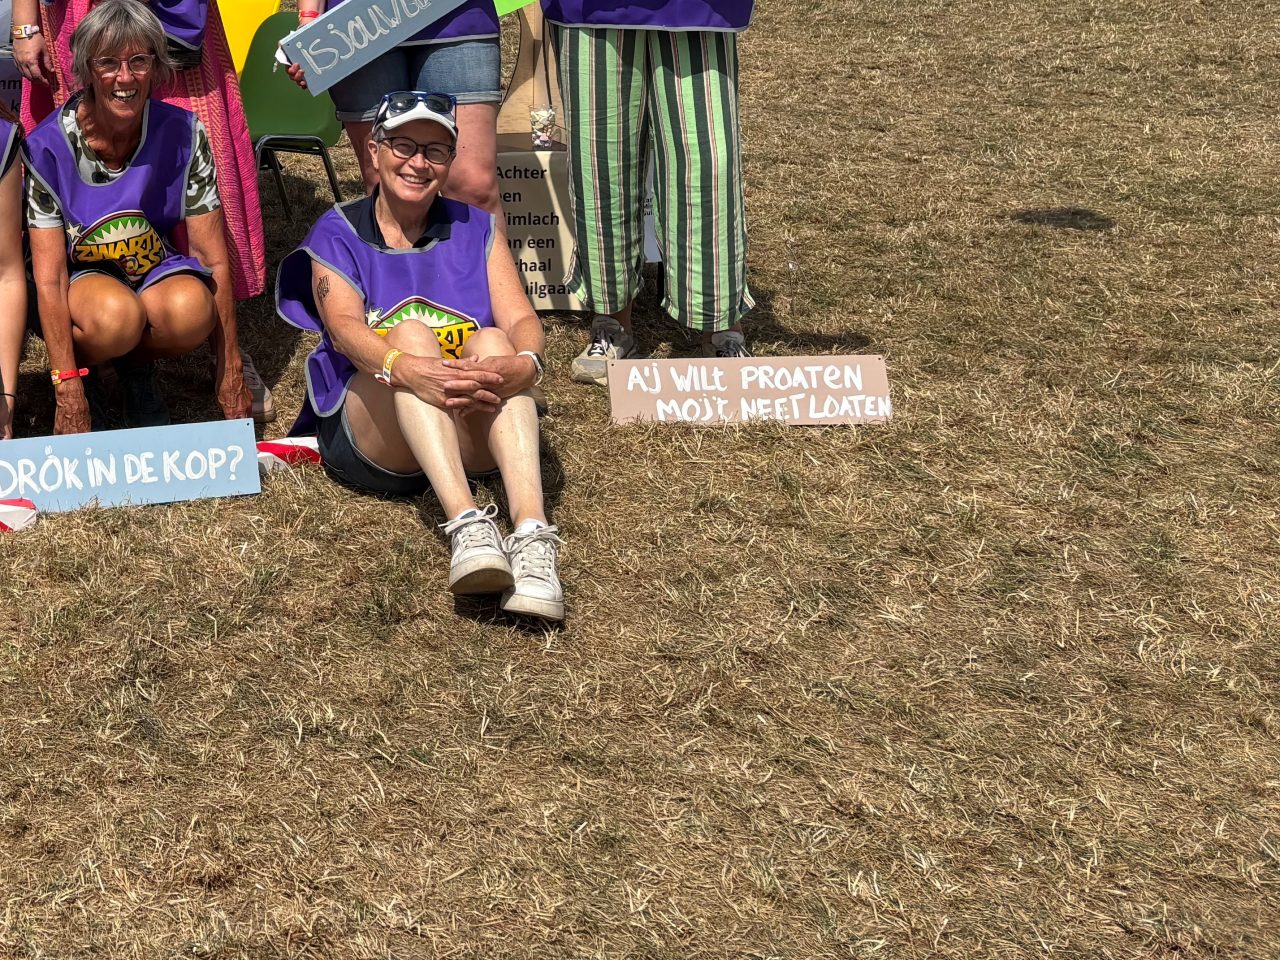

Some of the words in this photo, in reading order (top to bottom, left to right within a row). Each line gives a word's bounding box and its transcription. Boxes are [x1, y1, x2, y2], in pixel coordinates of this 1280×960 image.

[496, 165, 548, 179] Achter
[499, 191, 522, 202] en
[503, 211, 560, 226] imlach
[527, 238, 555, 249] een
[740, 393, 805, 421] NEET
[808, 394, 892, 418] LOATEN
[123, 451, 159, 484] DE
[162, 445, 244, 484] KOP?
